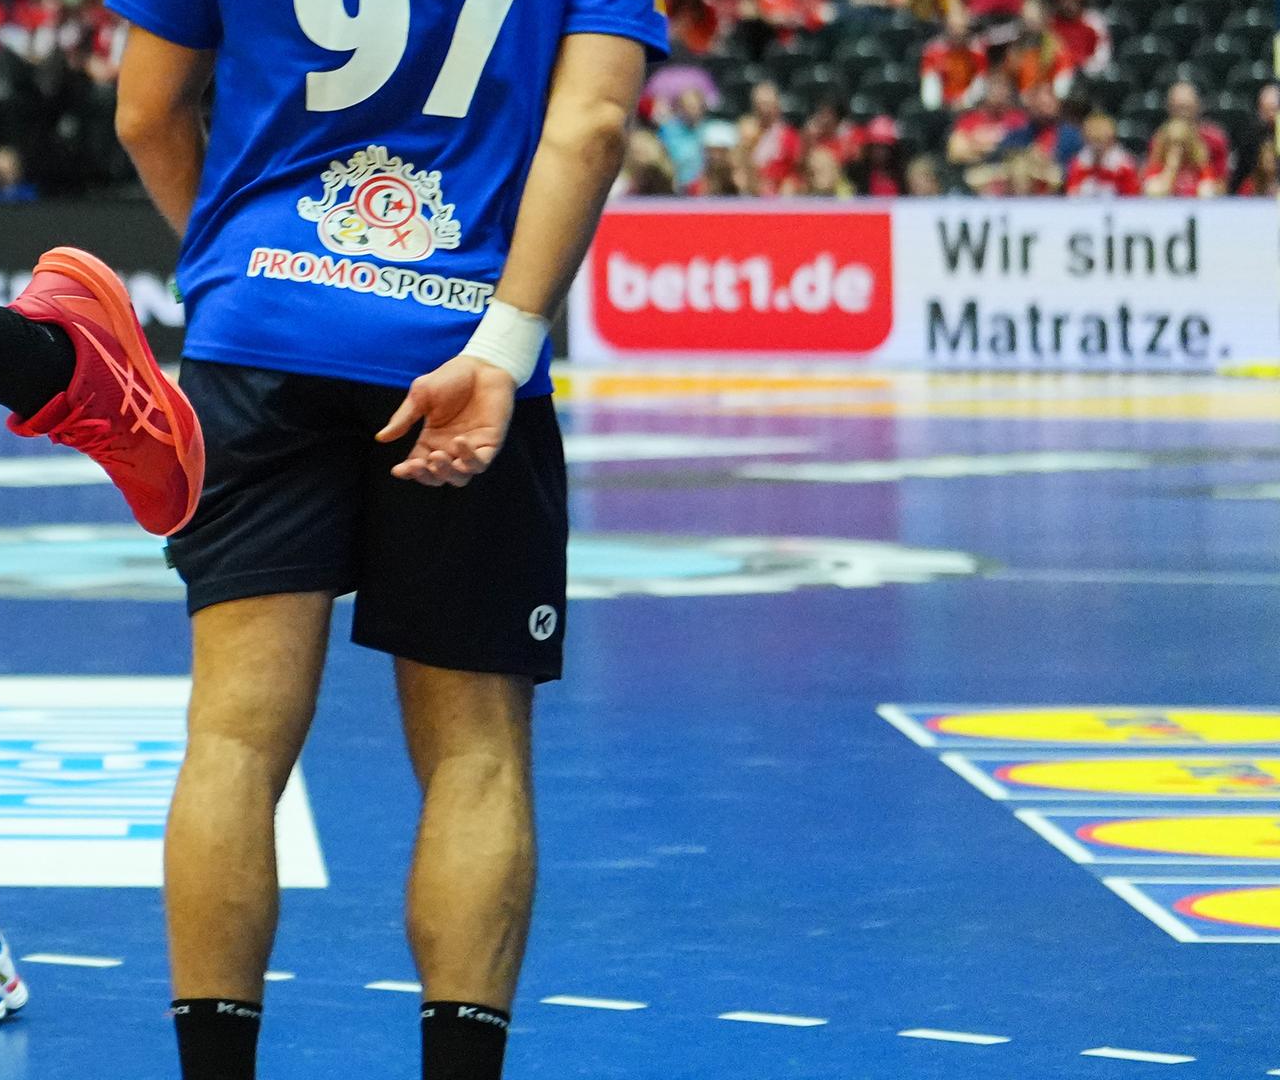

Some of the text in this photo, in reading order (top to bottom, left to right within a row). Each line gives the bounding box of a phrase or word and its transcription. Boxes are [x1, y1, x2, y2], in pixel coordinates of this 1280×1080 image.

[939, 216, 1199, 276] Wir sind
[248, 248, 496, 314] PROMOSPORT
[607, 255, 875, 314] bett1.de
[926, 302, 1231, 358] Matratze.
